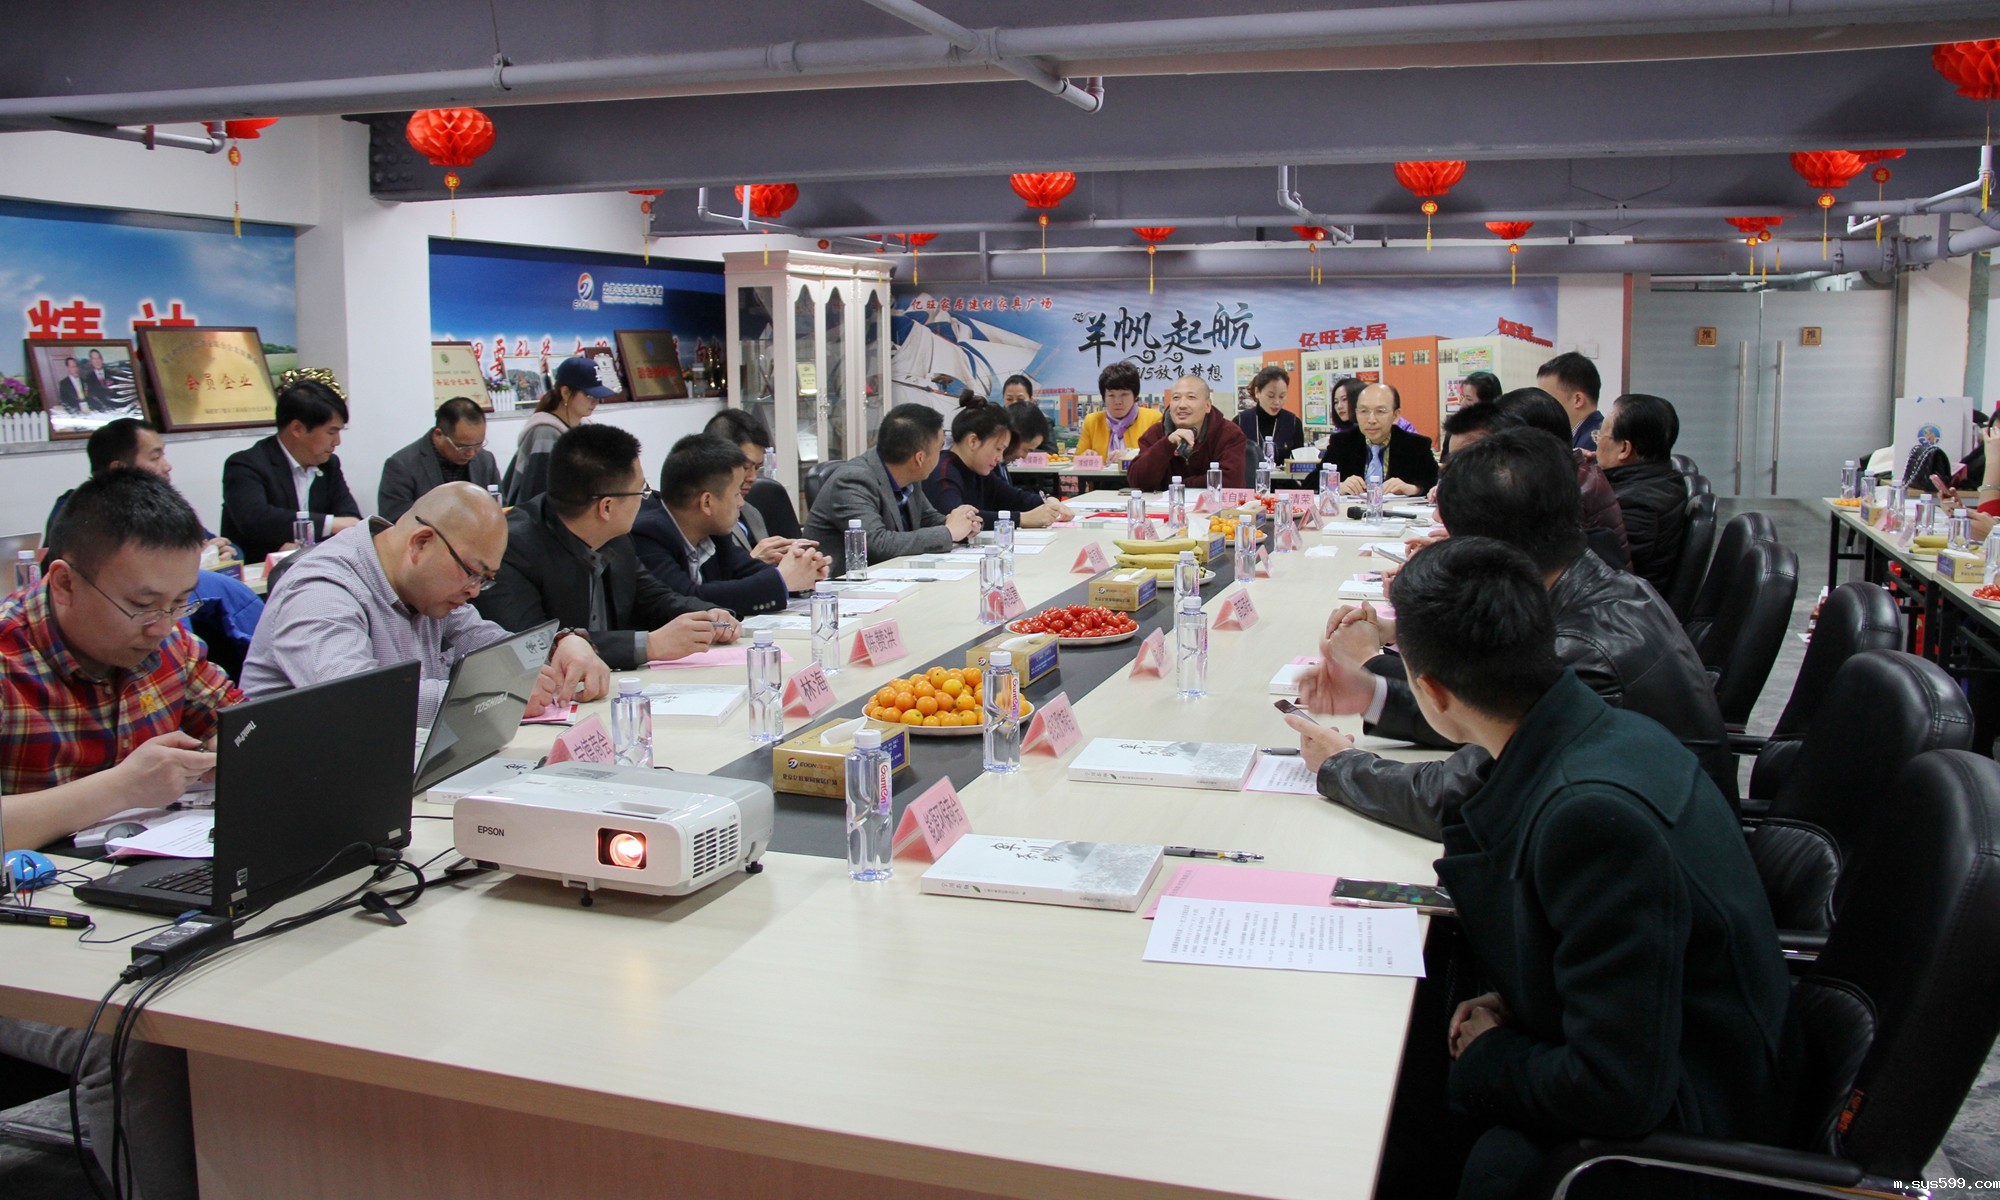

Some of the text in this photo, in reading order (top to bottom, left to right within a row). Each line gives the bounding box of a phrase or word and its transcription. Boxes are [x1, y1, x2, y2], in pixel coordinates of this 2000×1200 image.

[911, 296, 1053, 311] 亿旺家居建材家具广场
[1077, 301, 1261, 367] 羊帆起航
[1299, 323, 1389, 348] 亿旺家居
[185, 372, 253, 391] 会员企业
[1290, 493, 1311, 505] 清荣
[800, 671, 829, 702] 林海
[473, 691, 509, 716] TOSHIBA
[234, 720, 257, 748] ThinkPad
[477, 825, 505, 837] EPSON
